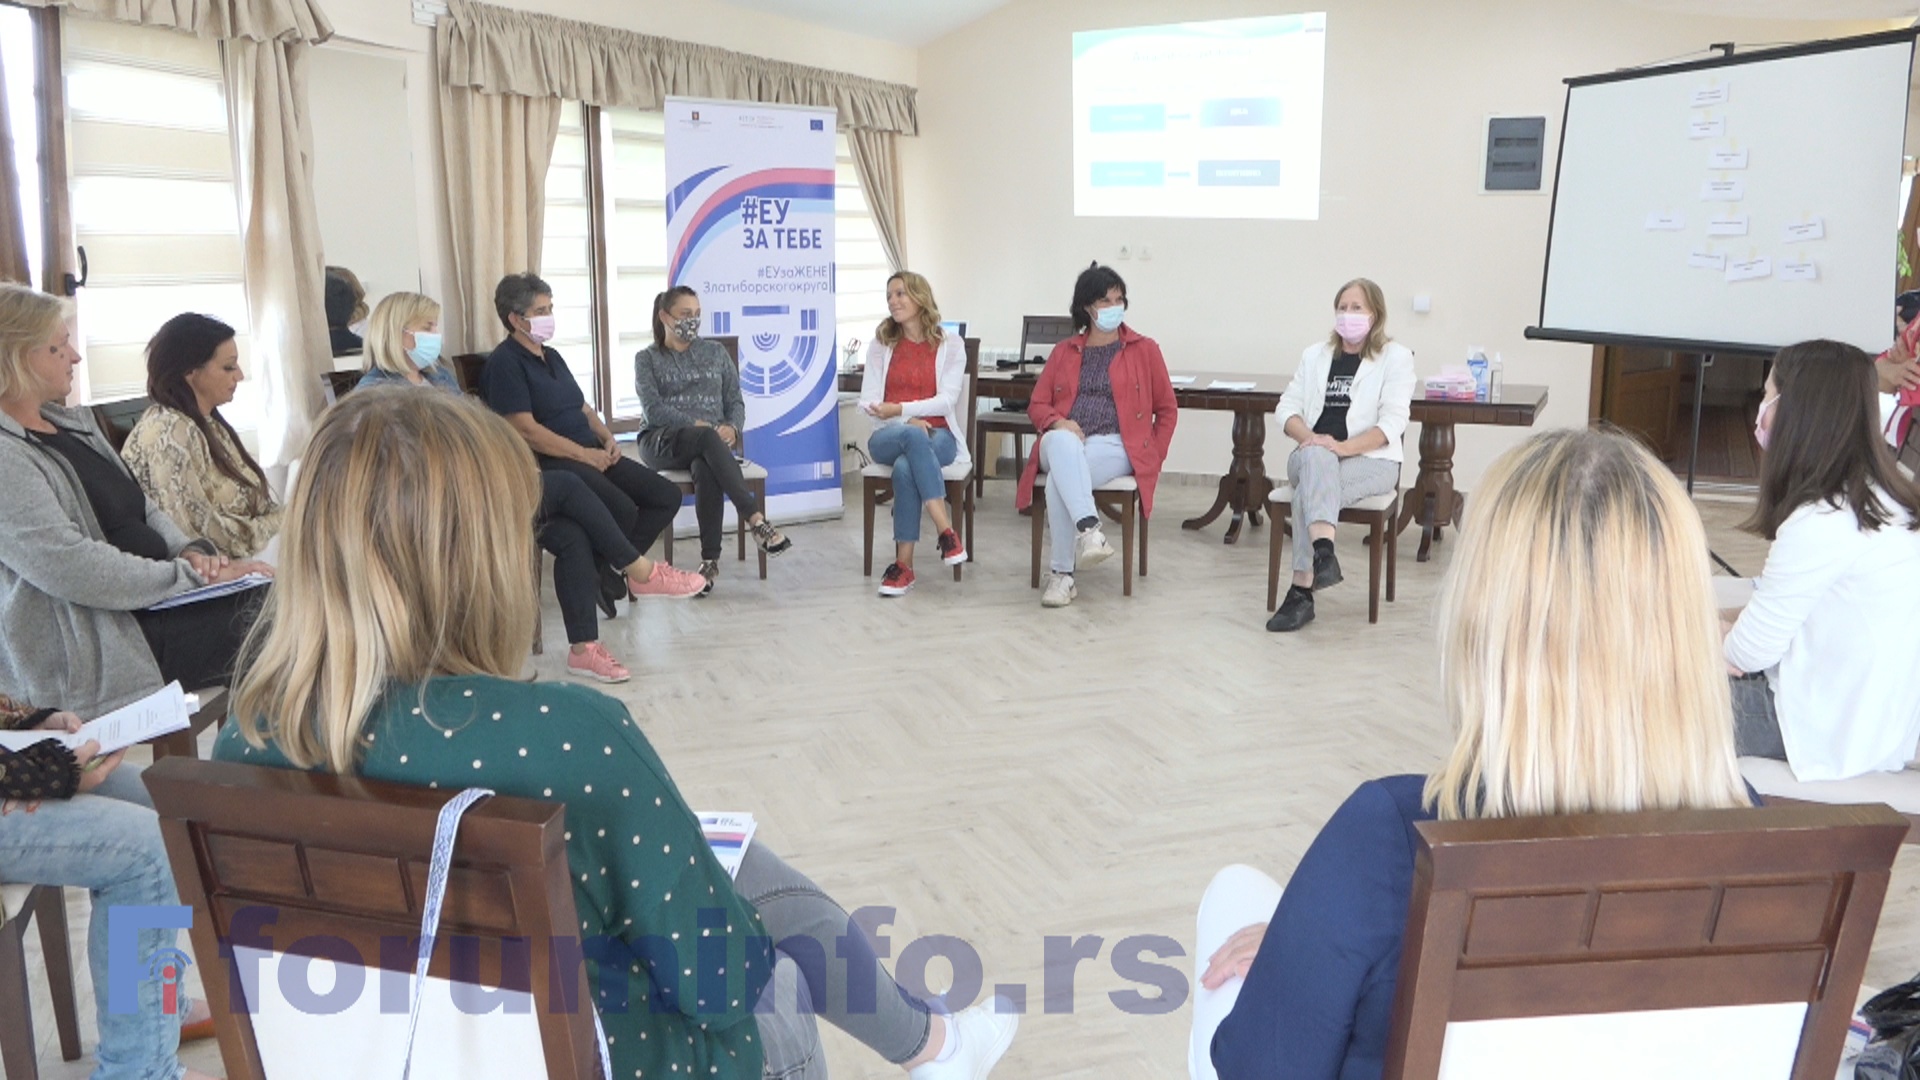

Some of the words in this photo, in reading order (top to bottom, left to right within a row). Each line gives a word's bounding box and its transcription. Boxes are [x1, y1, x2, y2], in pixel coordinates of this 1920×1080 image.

[742, 198, 790, 225] #ЕУ
[743, 228, 769, 249] ЗА
[774, 228, 822, 249] ТЕБЕ
[757, 265, 828, 279] #ЕУзаЖЕНЕ
